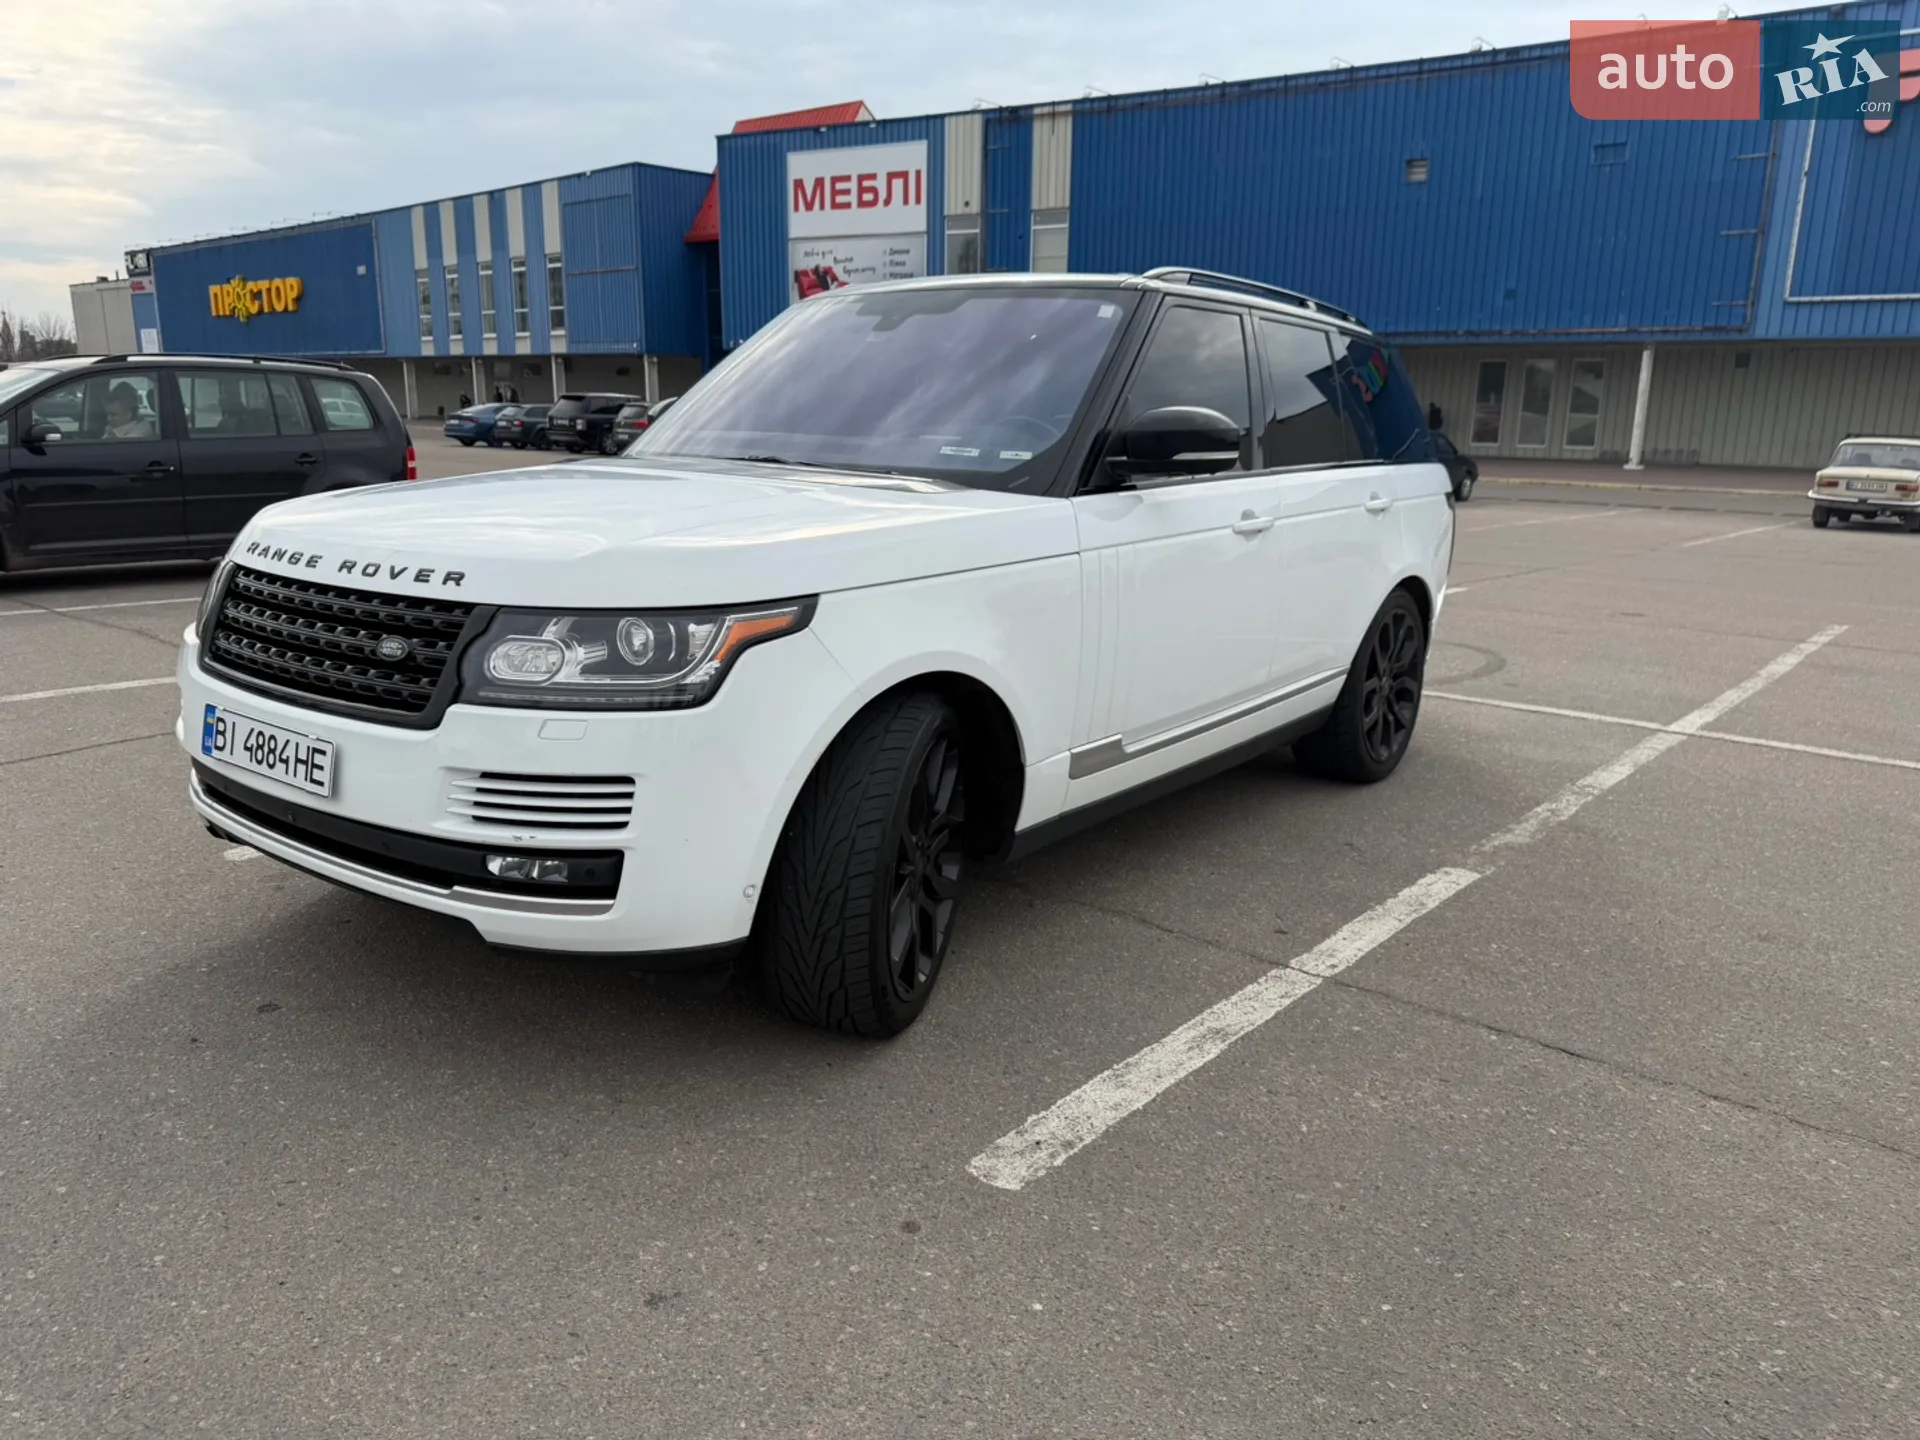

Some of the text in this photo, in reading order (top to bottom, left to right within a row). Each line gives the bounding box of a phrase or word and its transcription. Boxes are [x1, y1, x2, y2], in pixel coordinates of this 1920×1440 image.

[793, 169, 922, 213] МЕБЛІ
[246, 541, 466, 586] RANGE ROVER
[214, 716, 236, 756] BI
